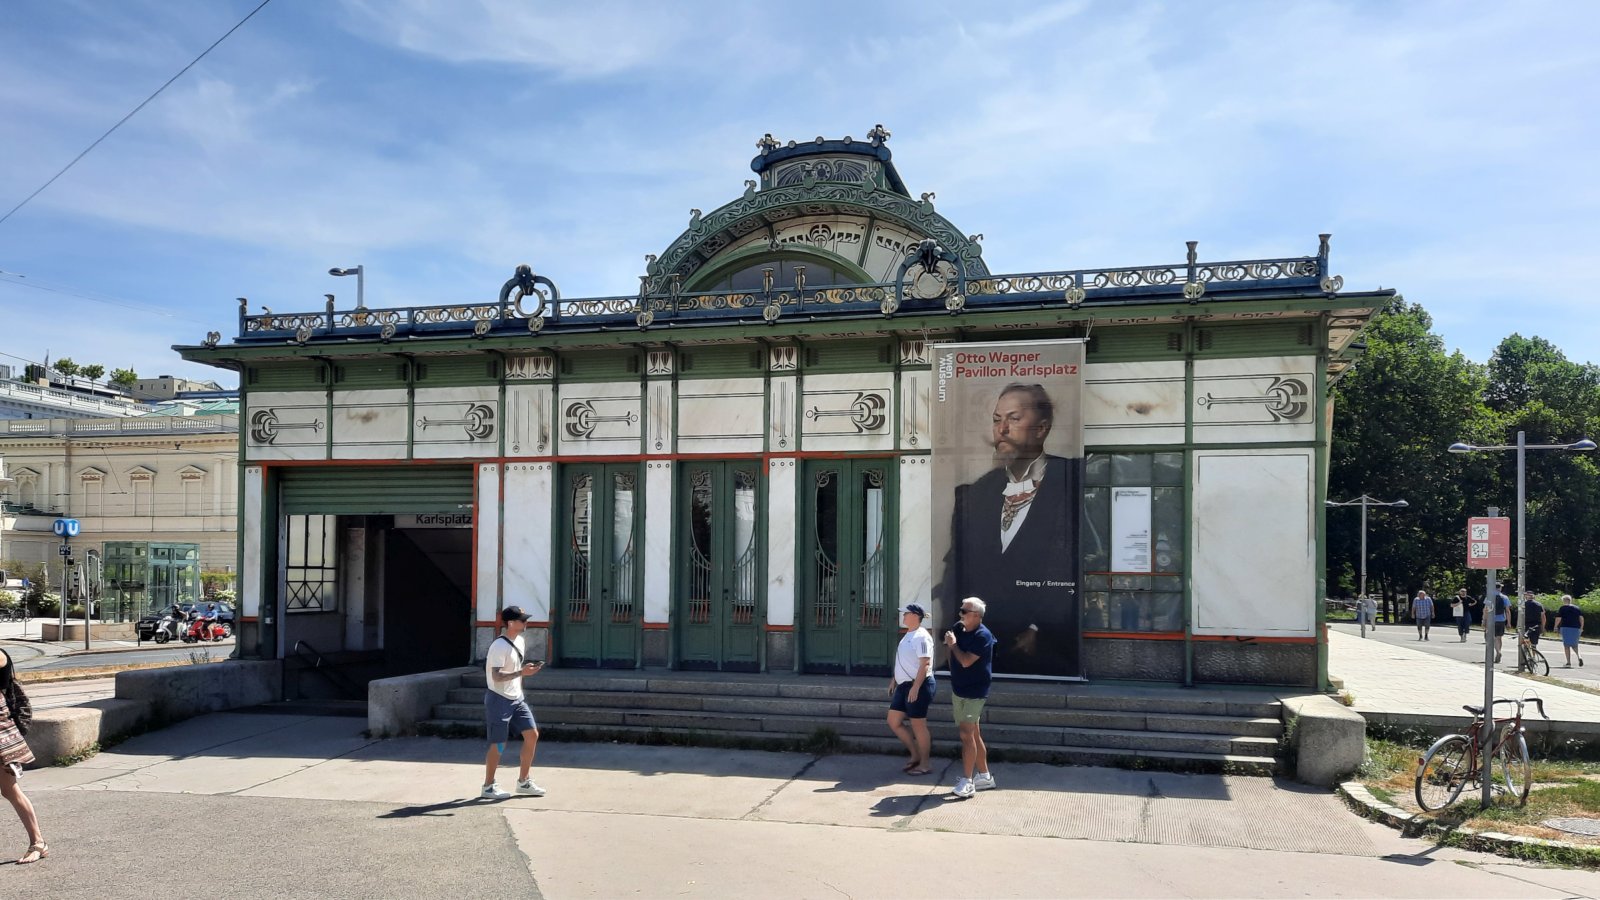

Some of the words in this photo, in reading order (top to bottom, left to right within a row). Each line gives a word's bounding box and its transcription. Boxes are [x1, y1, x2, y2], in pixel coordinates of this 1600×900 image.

[956, 353, 986, 364] Otto
[988, 352, 1040, 365] Wagner
[945, 353, 953, 379] wien
[956, 367, 1006, 378] Pavillon
[1010, 364, 1077, 378] Karlsplatz
[938, 357, 946, 402] museum
[416, 514, 472, 526] Karlsplatz
[55, 522, 64, 534] U
[69, 522, 78, 535] U
